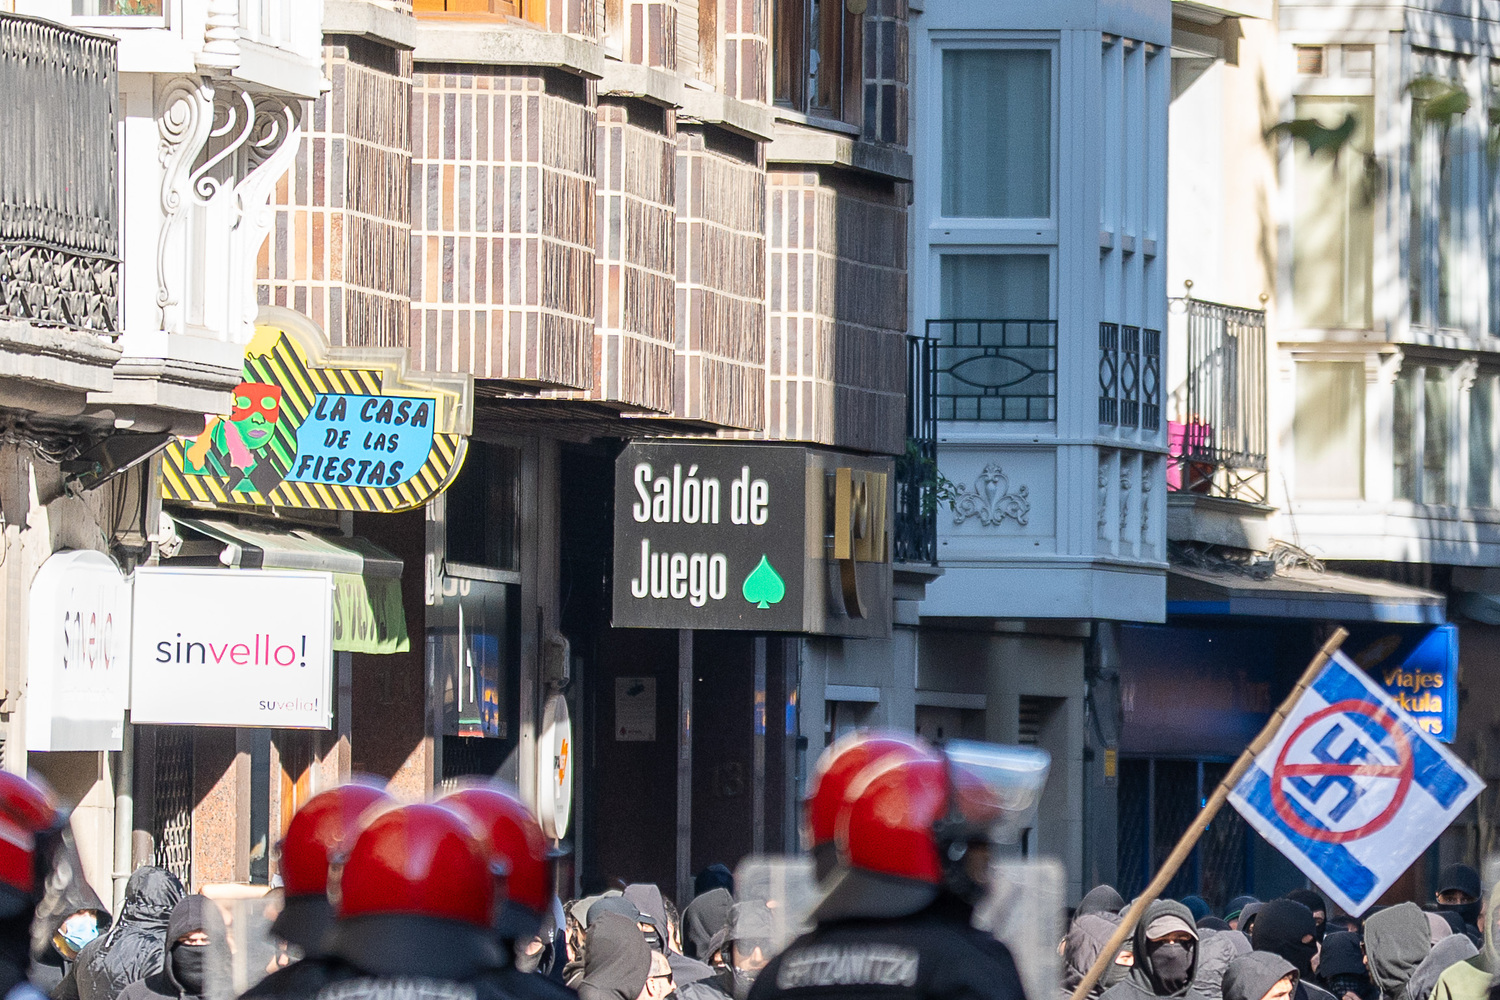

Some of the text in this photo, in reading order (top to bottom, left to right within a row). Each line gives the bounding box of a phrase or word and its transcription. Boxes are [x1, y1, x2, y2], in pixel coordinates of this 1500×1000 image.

[315, 395, 429, 428] LA CASA
[324, 428, 399, 453] DE LAS
[296, 454, 404, 486] FIESTAS
[633, 462, 769, 525] Salón de
[631, 538, 727, 607] Juego
[156, 633, 306, 667] sinvello!
[1383, 668, 1443, 692] Viajes
